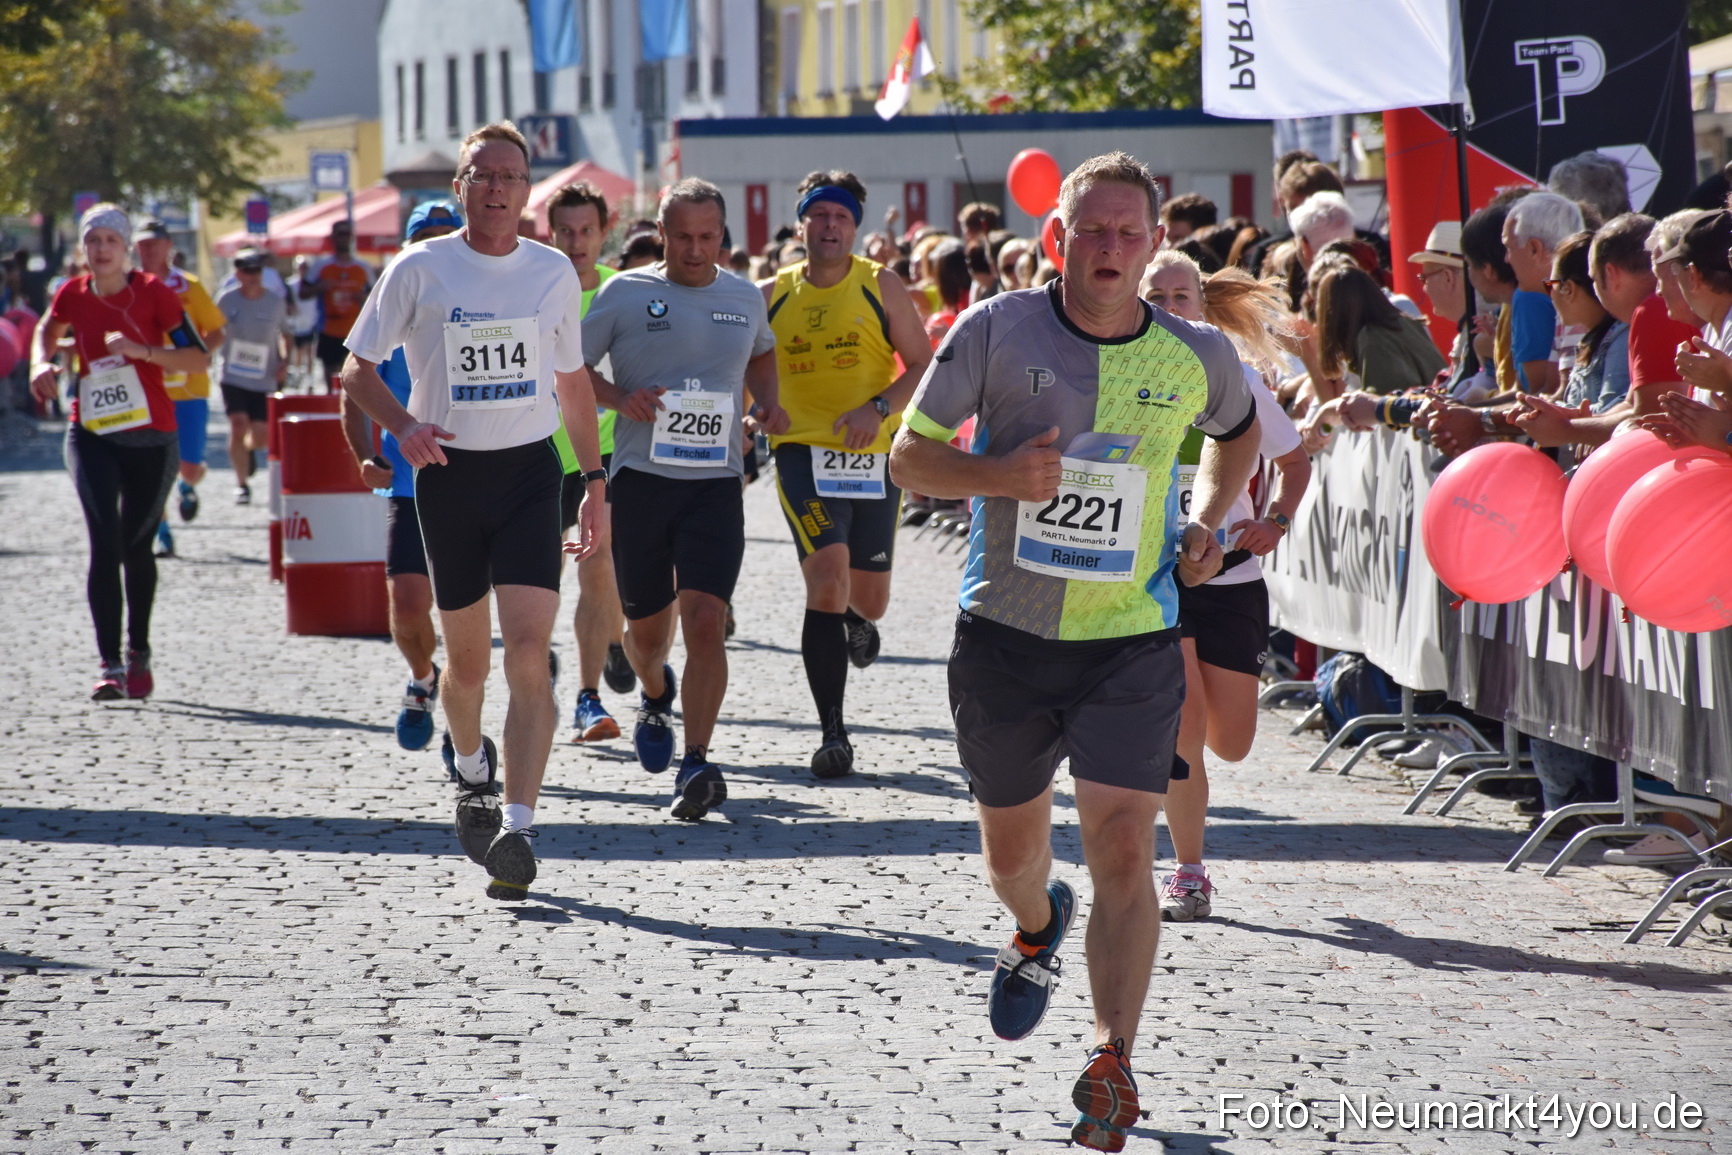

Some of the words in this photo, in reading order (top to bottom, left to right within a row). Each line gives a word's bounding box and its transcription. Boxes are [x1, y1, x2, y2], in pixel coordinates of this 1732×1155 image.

[1521, 47, 1548, 57] Team
[463, 311, 496, 319] Neumarkter
[711, 312, 748, 325] BOCK
[472, 326, 512, 338] BOCK
[460, 342, 528, 372] 3114
[91, 384, 129, 409] 266
[456, 383, 529, 400] STEFAN
[681, 398, 715, 408] BOCK
[667, 411, 723, 436] 2266
[673, 447, 712, 459] Erschda
[823, 451, 875, 470] 2123
[1061, 469, 1114, 487] BOCK
[837, 482, 863, 492] Alfred
[1036, 493, 1123, 532] 2221
[1041, 530, 1068, 541] PARTL
[1069, 534, 1106, 545] Neumarkt
[1051, 548, 1102, 568] Rainer
